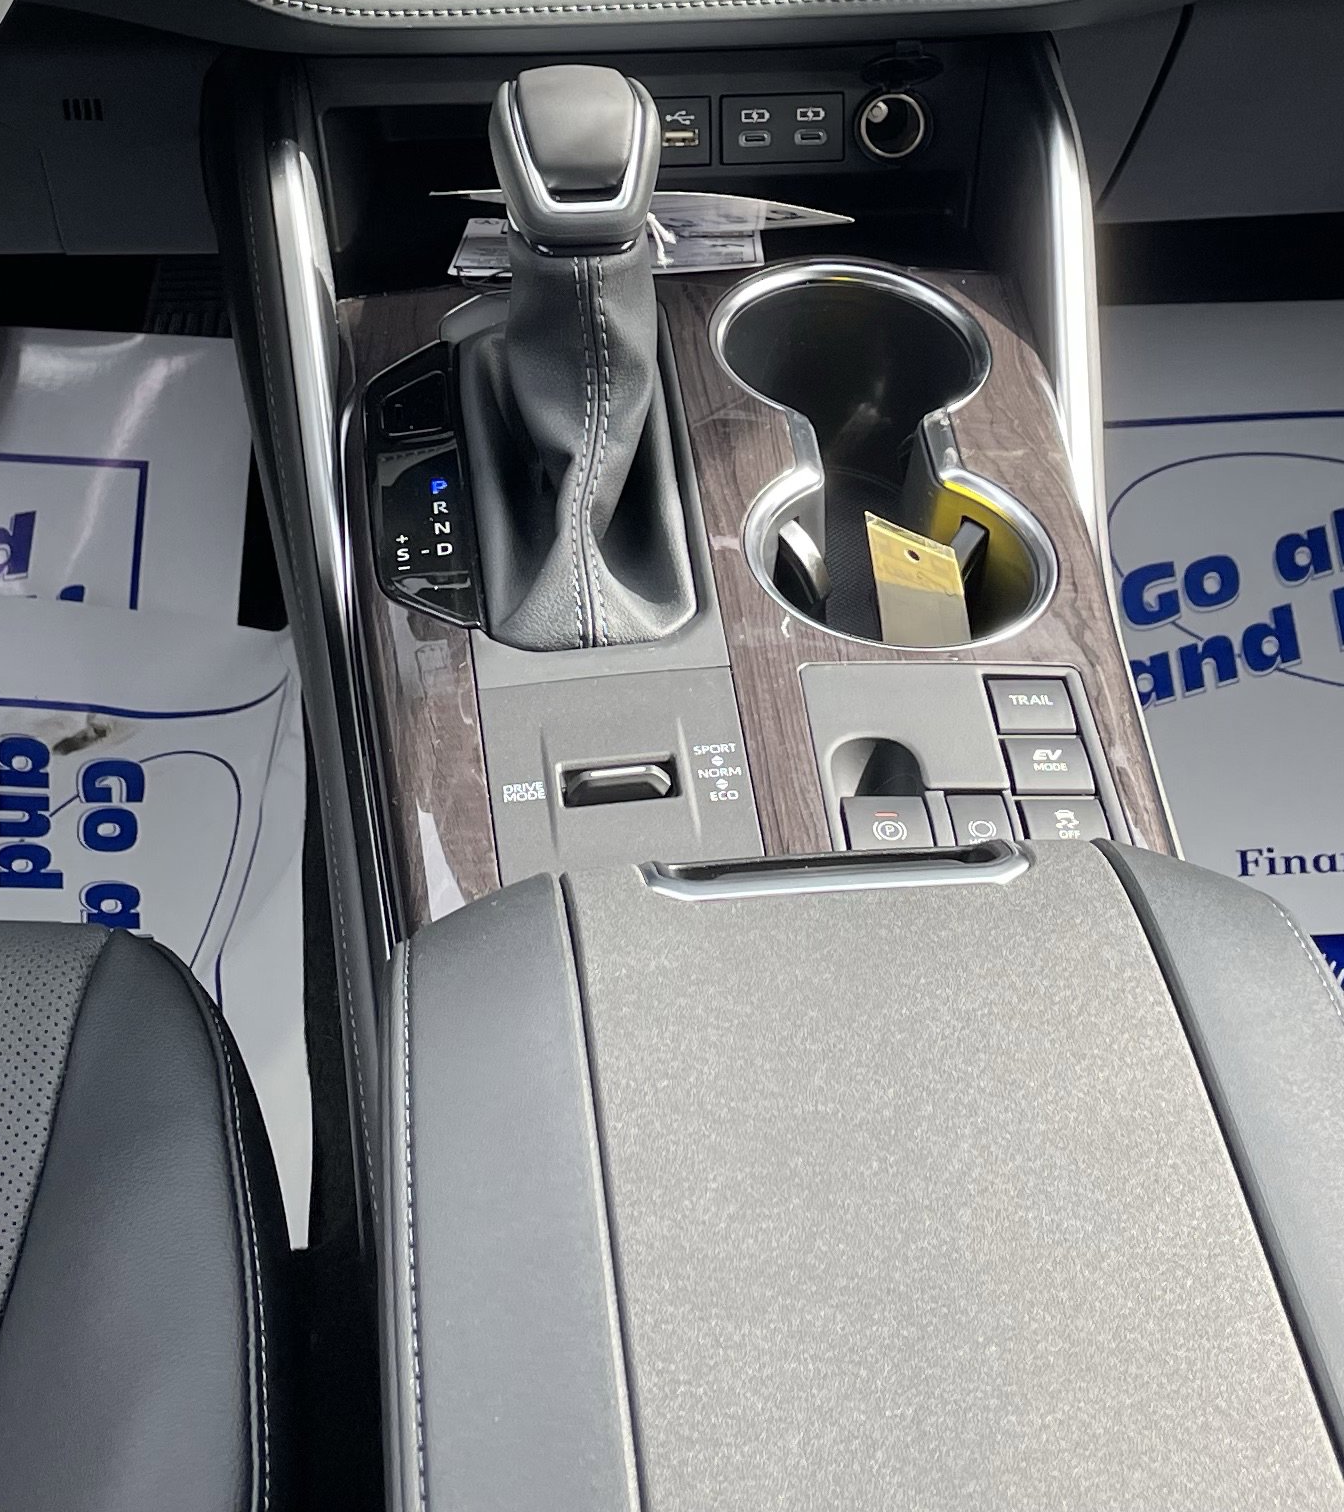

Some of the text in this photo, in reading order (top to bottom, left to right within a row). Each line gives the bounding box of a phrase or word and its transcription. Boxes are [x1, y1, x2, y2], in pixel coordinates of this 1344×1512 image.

[430, 477, 448, 495] P
[432, 501, 449, 515] R
[433, 521, 451, 535] N
[396, 548, 410, 562] S
[436, 542, 453, 556] D
[1121, 551, 1242, 630] Go
[1128, 603, 1302, 712] and
[1008, 694, 1054, 707] TRAIL
[692, 742, 737, 756] SPORT
[1032, 749, 1063, 761] EV
[697, 766, 742, 779] NORM
[1033, 762, 1068, 772] MODE
[502, 781, 544, 793] DRIVE
[502, 790, 546, 803] MODE
[709, 790, 739, 802] ECO
[76, 756, 146, 853] Go
[1058, 829, 1080, 839] OFF
